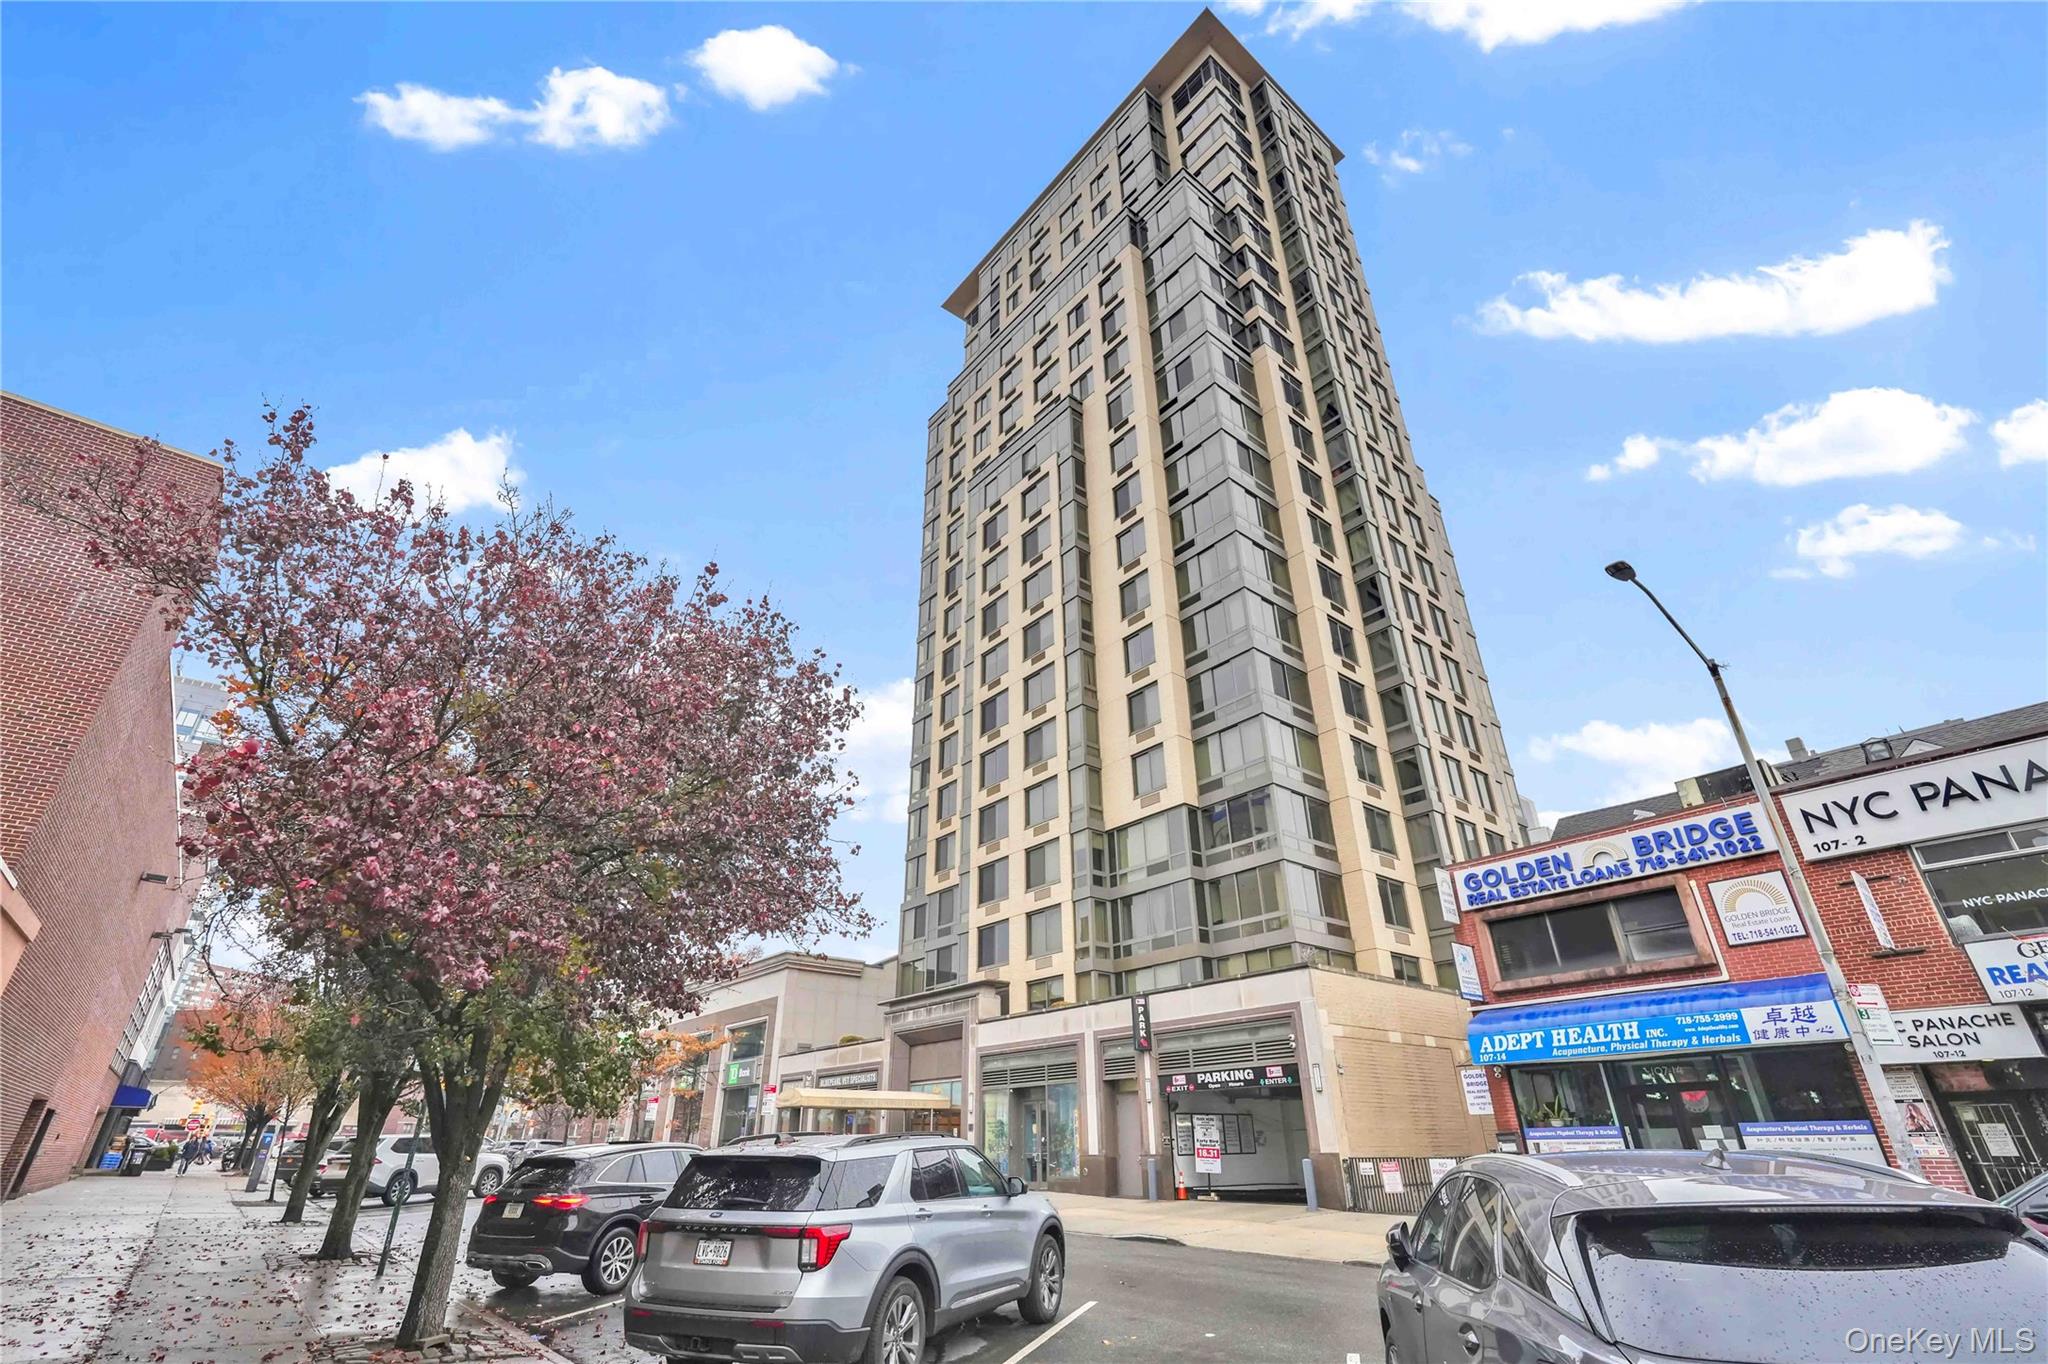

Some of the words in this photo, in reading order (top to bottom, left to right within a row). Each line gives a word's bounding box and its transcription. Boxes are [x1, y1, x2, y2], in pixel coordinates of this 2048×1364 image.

[1800, 790, 1899, 834] NYC
[1464, 852, 1572, 892] GOLDEN
[1632, 811, 1760, 857] BRIDGE
[1467, 886, 1507, 906] REAL
[1511, 875, 1571, 899] ESTATE
[1572, 861, 1632, 885] LOANS
[1636, 835, 1765, 873] 718-541-1022
[1962, 896, 1993, 908] NYC
[1995, 888, 2048, 905] PANAC
[1724, 911, 1759, 923] GOLDEN
[1760, 906, 1791, 918] BRIDGE
[1732, 921, 1747, 929] Real
[1748, 918, 1770, 927] Estate
[1771, 915, 1791, 924] Loans
[1986, 961, 2048, 986] REA
[1138, 1006, 1147, 1037] PARK
[1675, 1012, 1738, 1025] 718-755-2999
[1761, 1005, 1818, 1026] 卓越
[1912, 1012, 2016, 1032] PANACHE
[1479, 1031, 1546, 1053] ADEPT
[1552, 1021, 1641, 1046] HEALTH
[1645, 1028, 1668, 1039] INC.
[1752, 1025, 1835, 1041] 健康中心
[1907, 1032, 1981, 1048] SALON
[1552, 1046, 1608, 1057] Acupuncture,
[1610, 1041, 1648, 1053] Physical
[1651, 1038, 1688, 1048] Therapy
[1691, 1035, 1698, 1045] &
[1702, 1033, 1741, 1044] Herbals
[1933, 1050, 1966, 1058] 107-12
[1480, 1053, 1506, 1062] 107-14
[1197, 1069, 1254, 1084] PARKING
[1265, 1077, 1287, 1085] ENTER
[675, 1225, 748, 1233] EXPLORER
